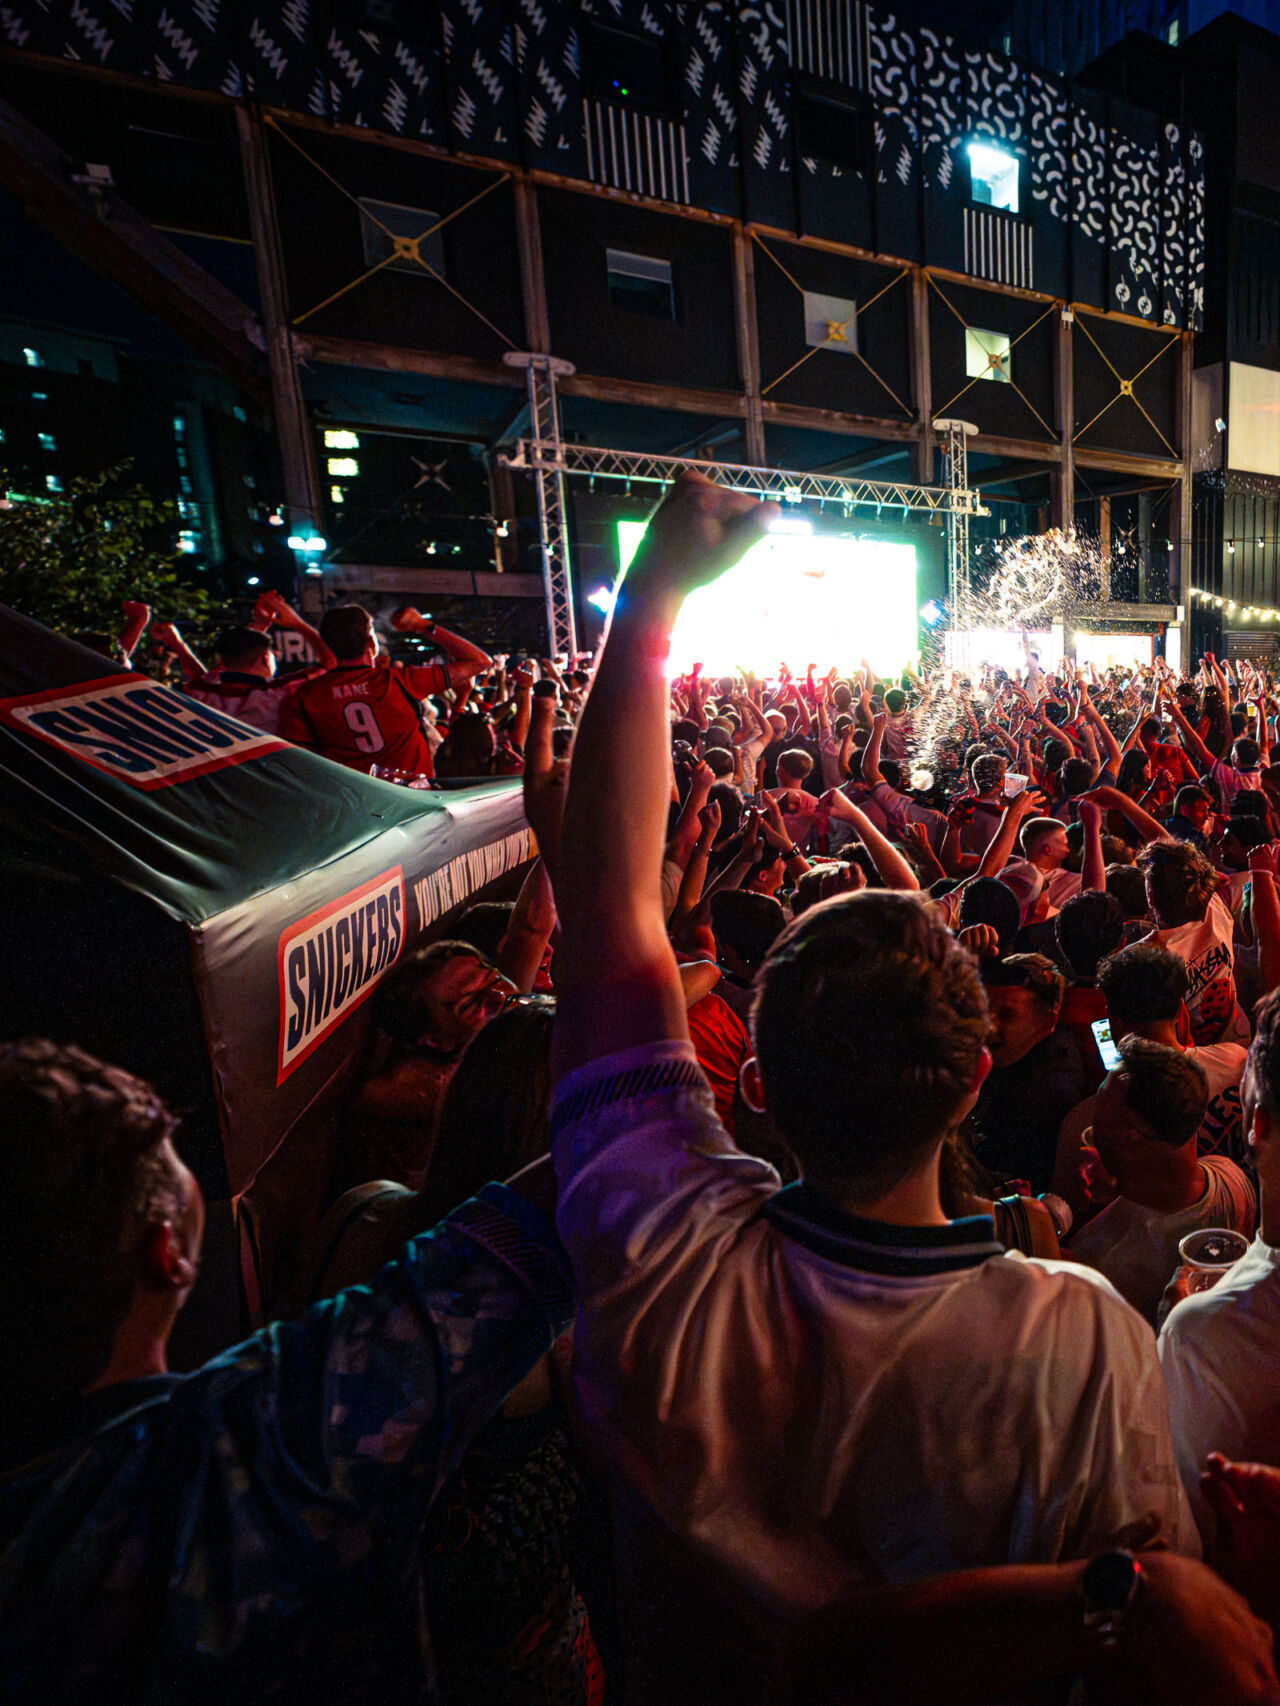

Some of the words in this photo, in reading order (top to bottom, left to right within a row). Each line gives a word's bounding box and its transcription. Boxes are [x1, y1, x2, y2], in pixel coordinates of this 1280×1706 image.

[331, 682, 369, 700] KANE
[343, 701, 385, 754] 9
[413, 862, 453, 932] YOU'RE
[449, 854, 469, 906] NOT
[467, 846, 487, 895] YOU
[287, 885, 401, 1052] SNICKERS
